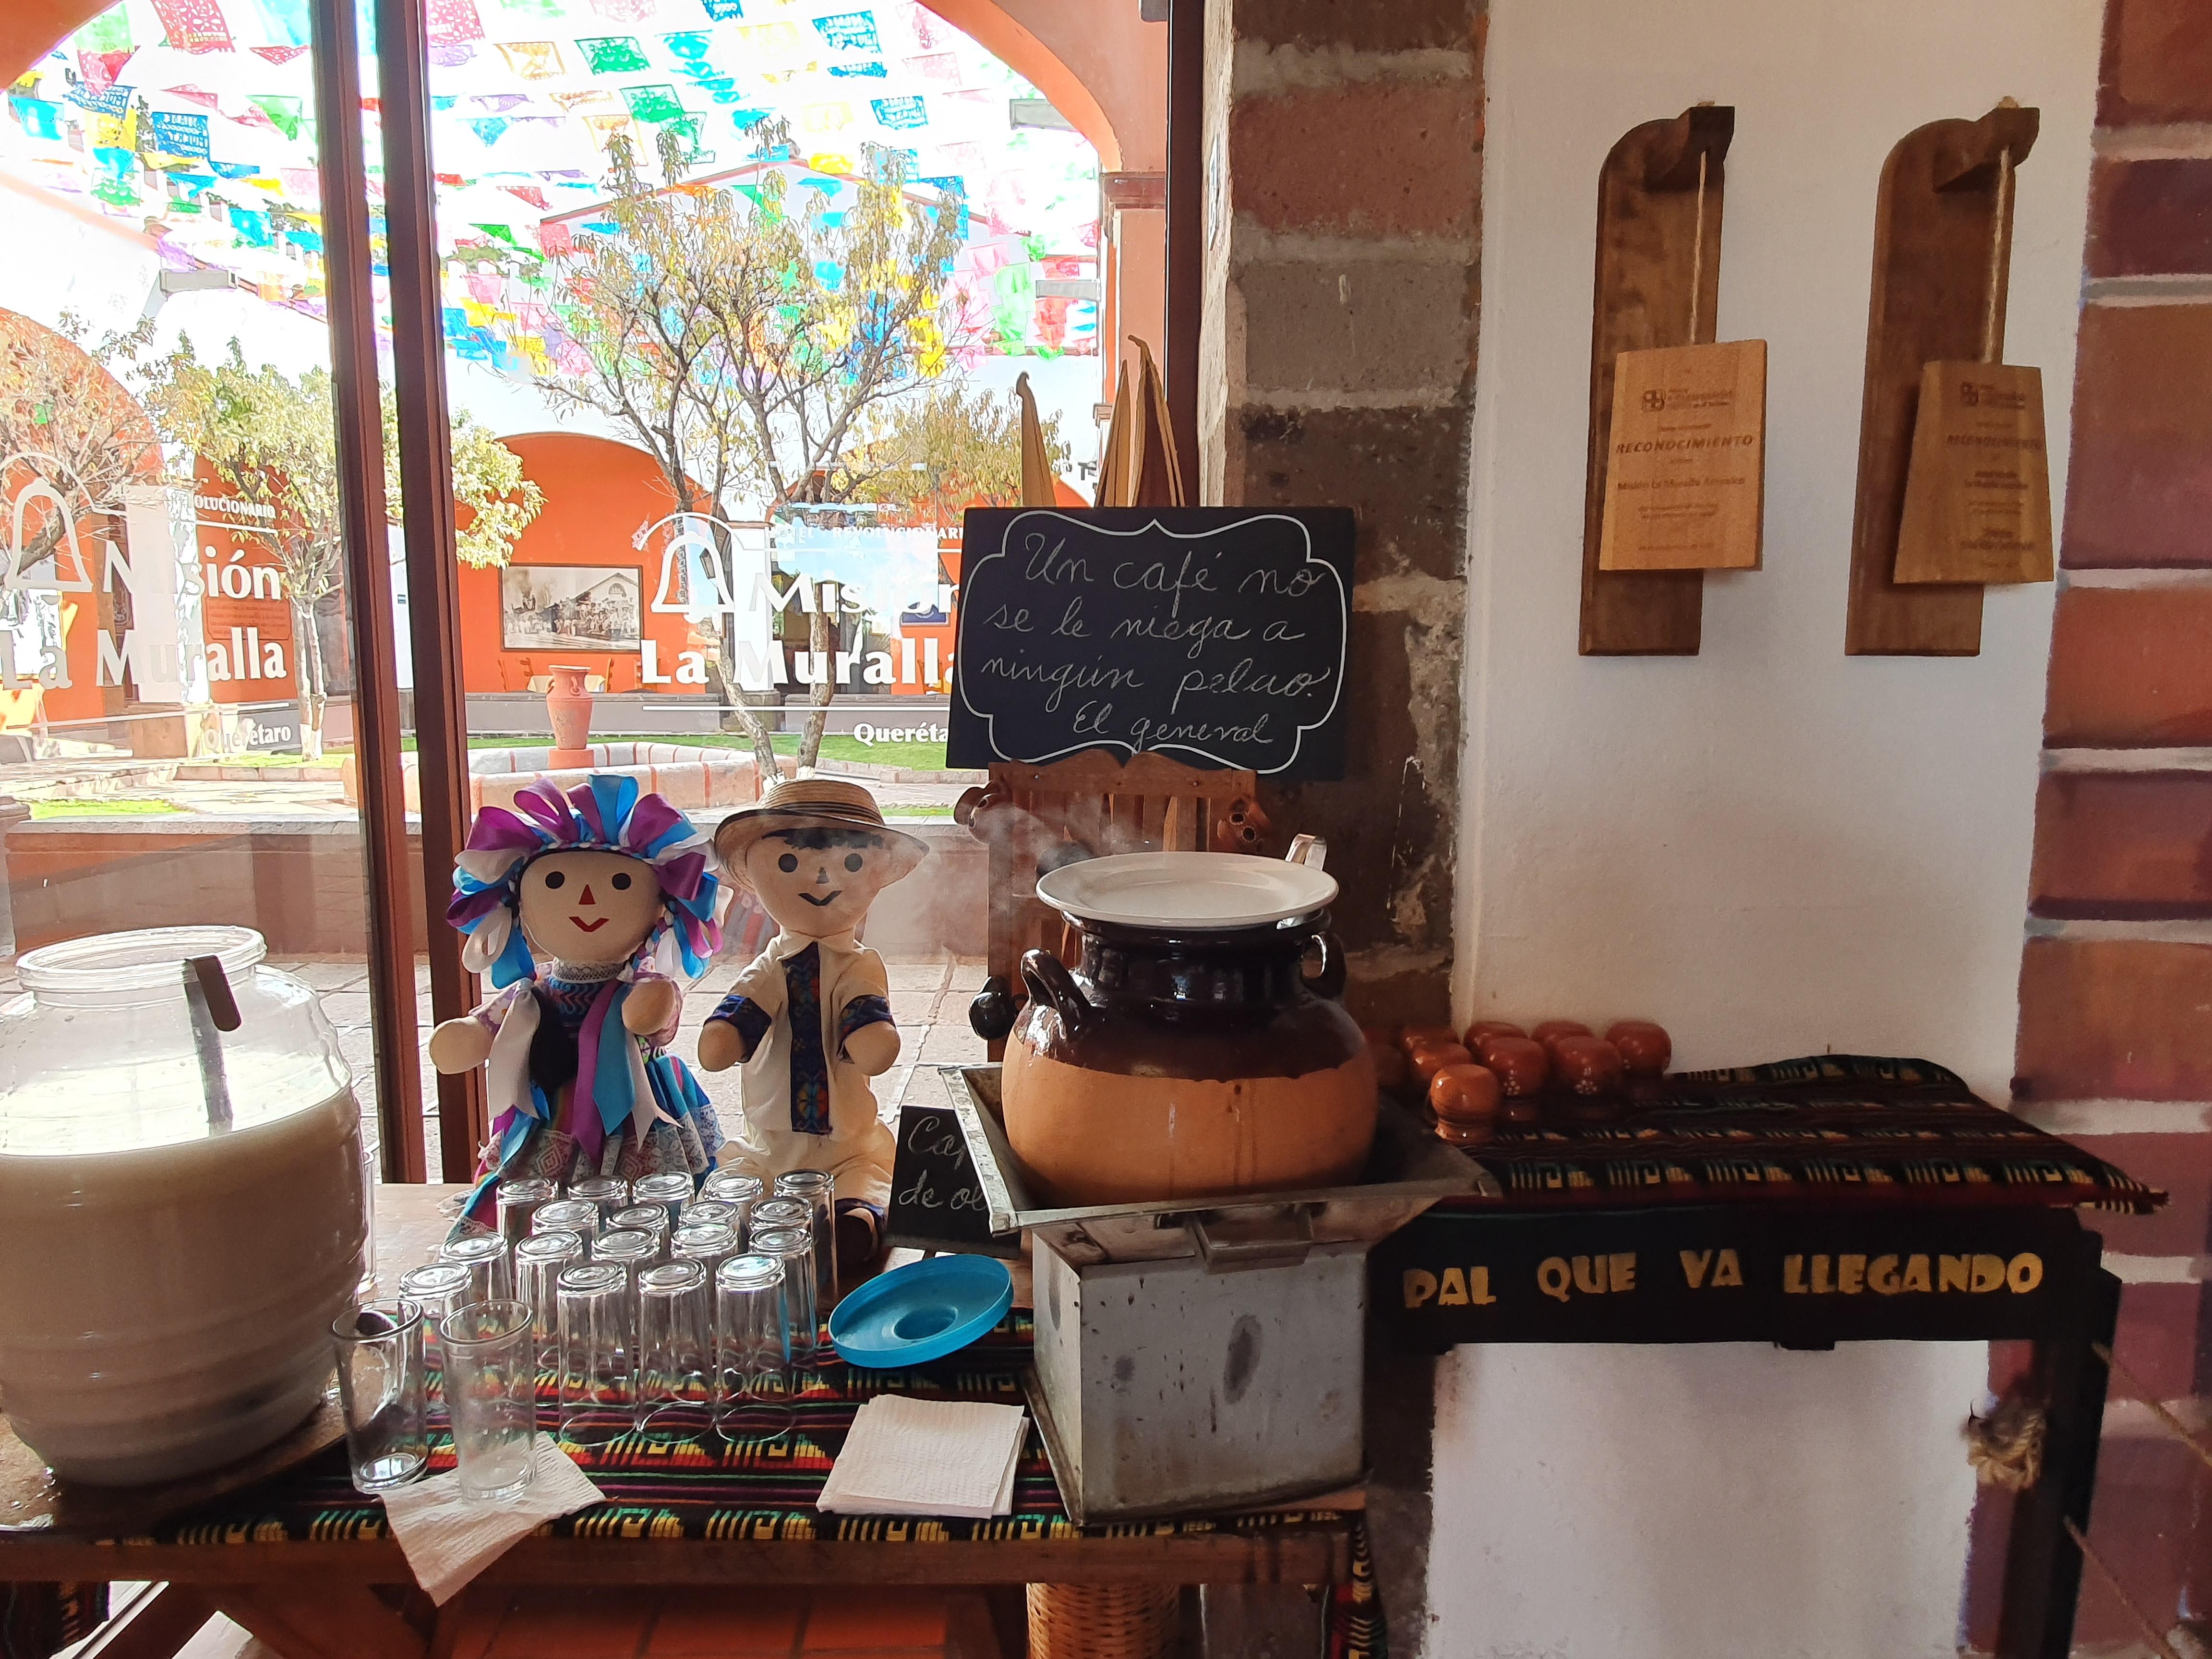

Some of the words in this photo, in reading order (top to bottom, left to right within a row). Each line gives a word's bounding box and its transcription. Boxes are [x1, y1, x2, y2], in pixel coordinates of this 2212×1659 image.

[1616, 434, 1754, 454] RECONOCIMIENTO
[1024, 532, 1094, 585] Un
[1113, 550, 1223, 618] café
[1238, 568, 1328, 598] no
[0, 629, 72, 689] La
[96, 626, 287, 686] Muralla
[982, 605, 1034, 633] se
[1051, 596, 1092, 638] le
[1110, 605, 1252, 660] niega
[1262, 620, 1308, 641] a
[641, 638, 709, 685] La
[733, 637, 954, 685] Murall
[981, 648, 1144, 714] ningún
[1072, 700, 1114, 735] El
[1130, 713, 1274, 755] general
[898, 1169, 944, 1208] de
[1403, 1265, 1497, 1309] PAL
[1537, 1252, 1636, 1303] QUE
[1679, 1249, 1743, 1288] VA
[1783, 1252, 2044, 1295] LLEGANDO
